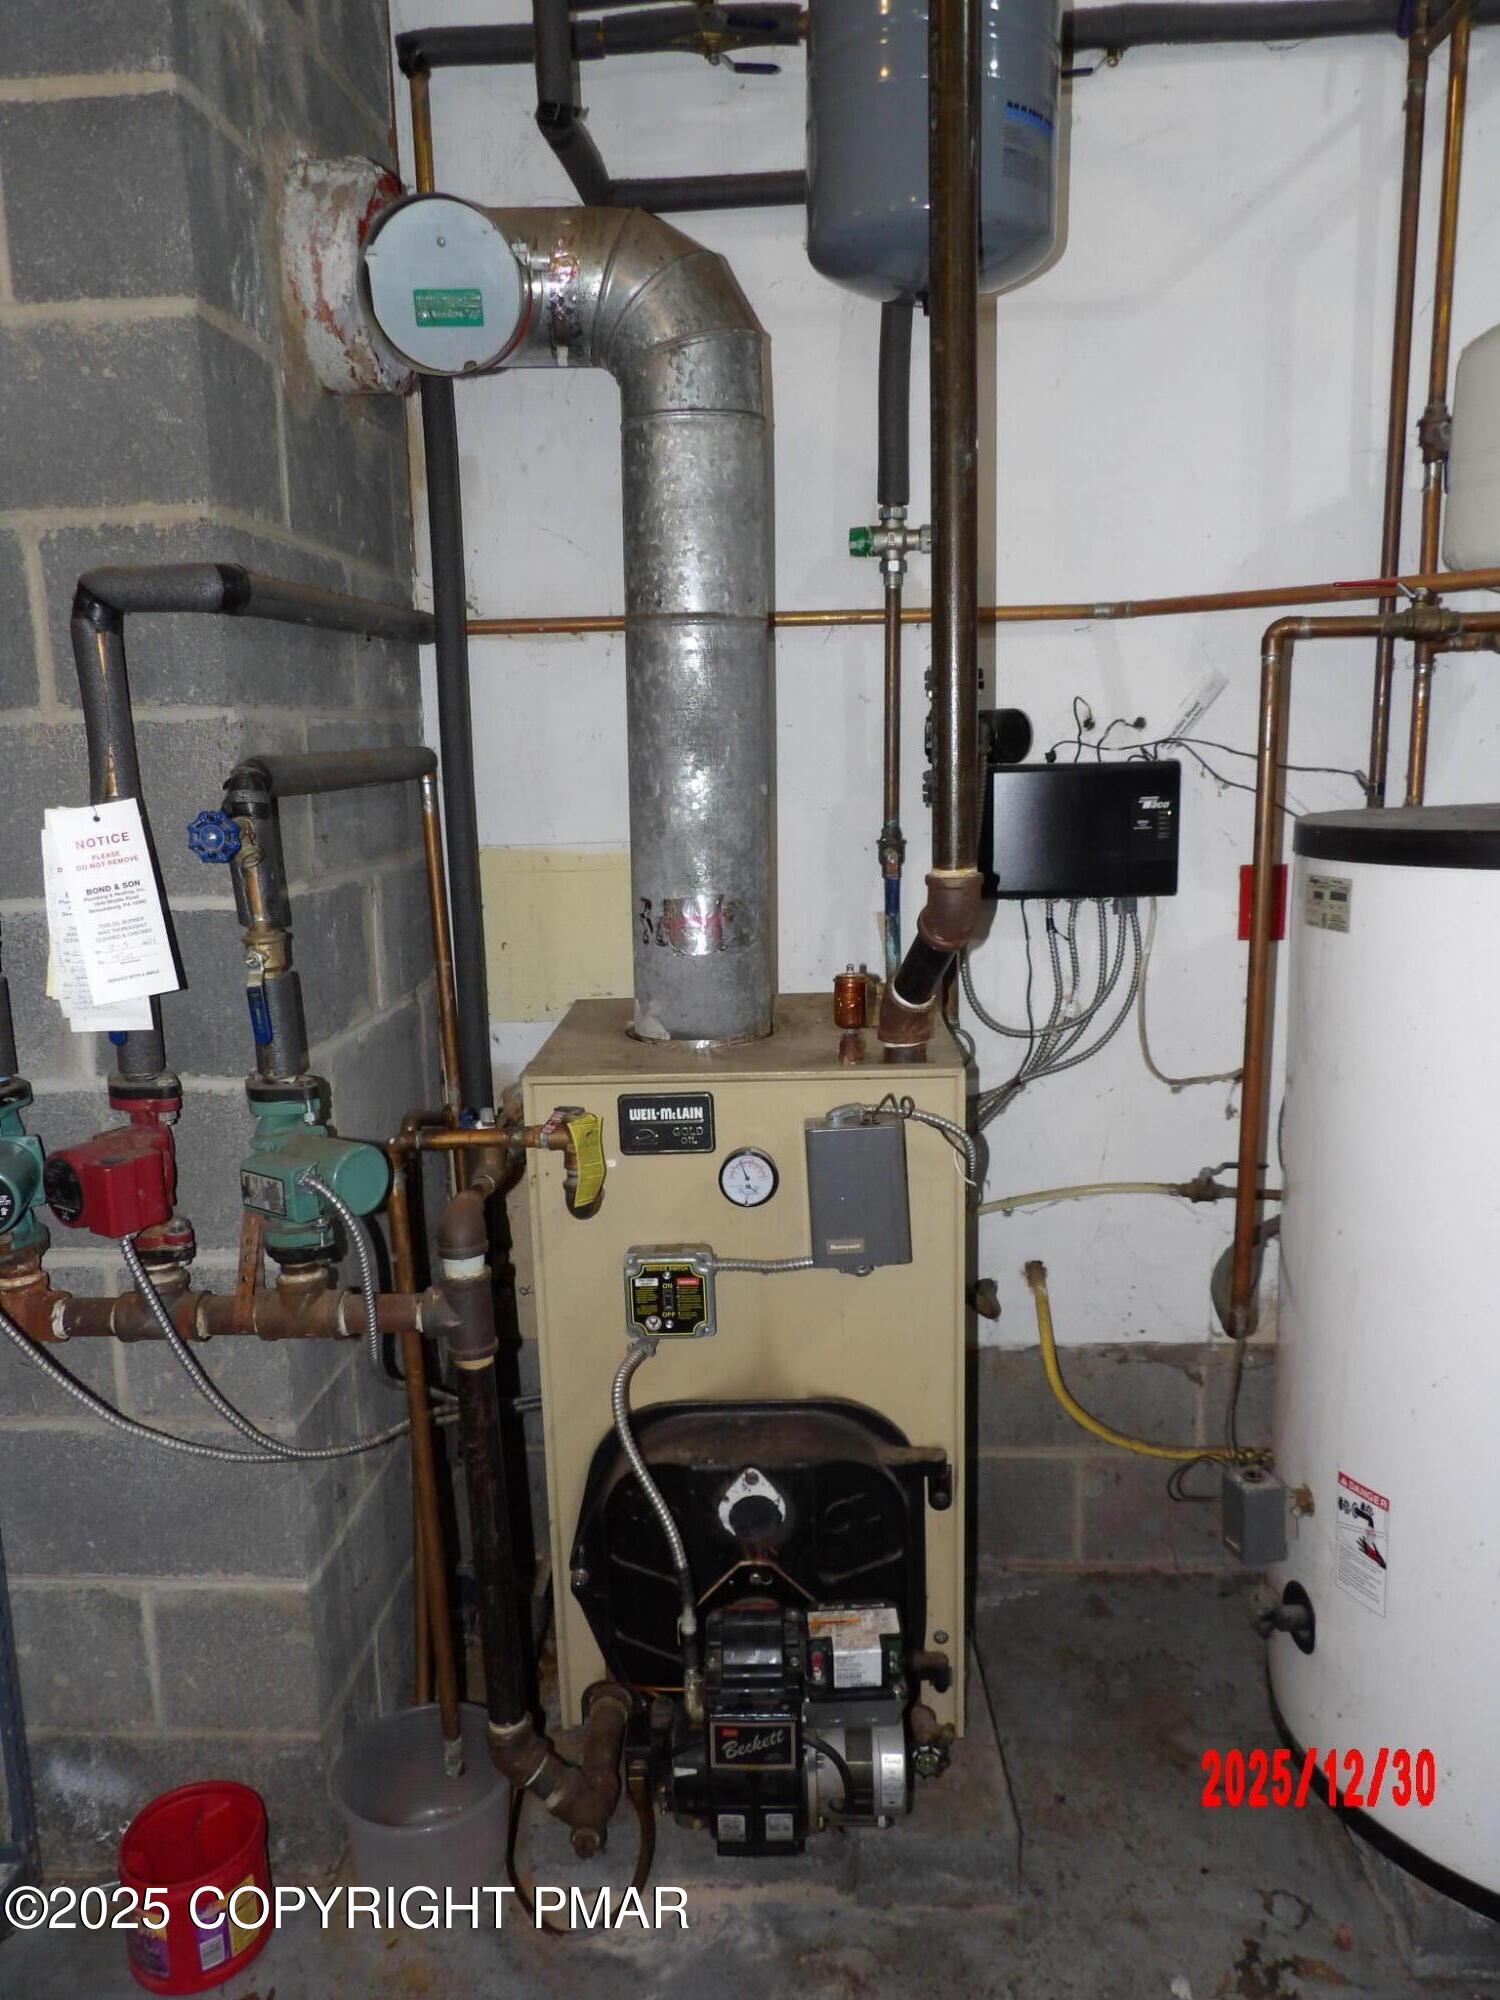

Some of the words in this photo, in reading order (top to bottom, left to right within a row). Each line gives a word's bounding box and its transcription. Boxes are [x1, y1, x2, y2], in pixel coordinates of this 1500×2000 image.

[1138, 796, 1171, 809] Taco
[75, 831, 130, 850] NOTICE
[91, 850, 120, 860] PLEASE
[76, 864, 88, 872] DO
[89, 861, 105, 870] NOT
[107, 854, 139, 866] REMOVE
[86, 884, 112, 896] BOND
[114, 883, 121, 891] &
[122, 879, 141, 889] SON
[673, 1127, 704, 1137] GOLD
[680, 1137, 698, 1145] OIL
[722, 1729, 785, 1760] Beckett
